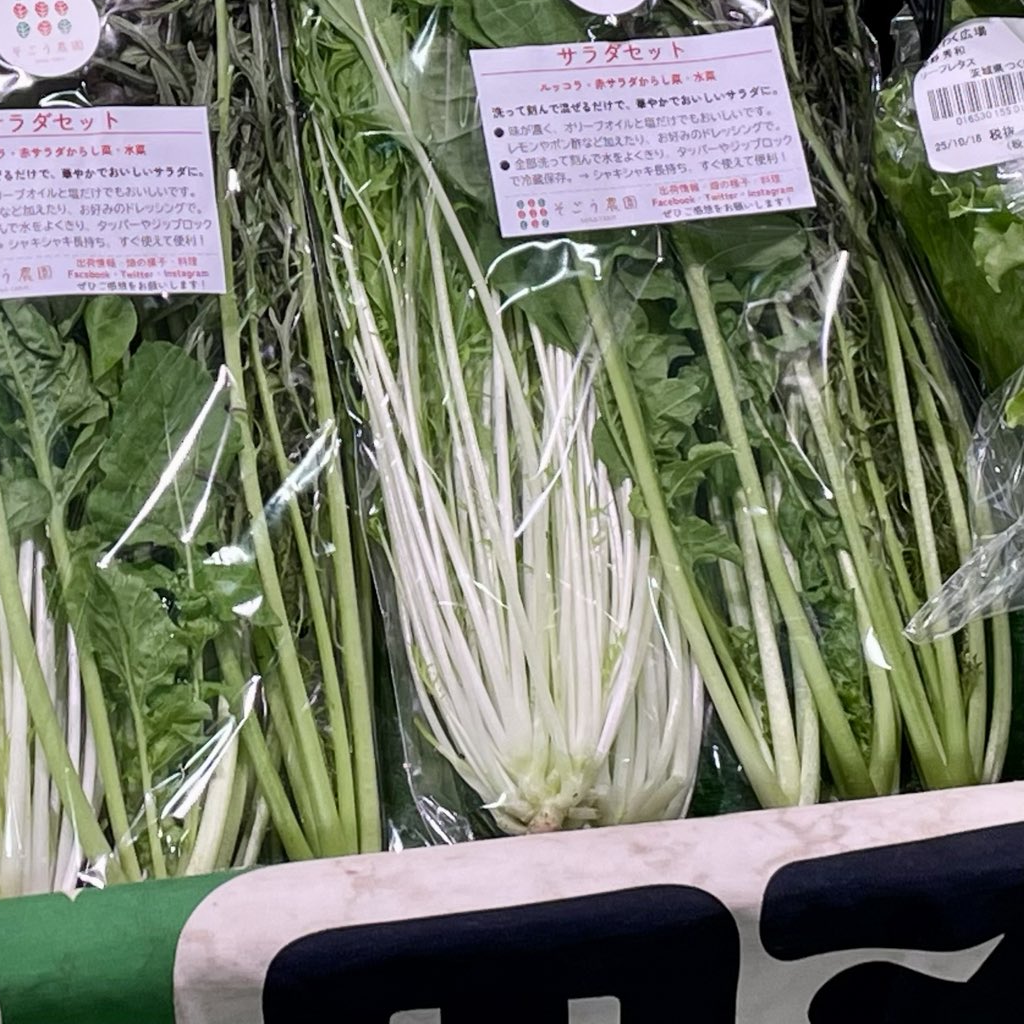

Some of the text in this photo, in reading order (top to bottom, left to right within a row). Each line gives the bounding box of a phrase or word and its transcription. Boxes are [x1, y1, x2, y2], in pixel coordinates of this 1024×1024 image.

[557, 41, 685, 66] サラダセット
[554, 195, 637, 216] そごう農園
